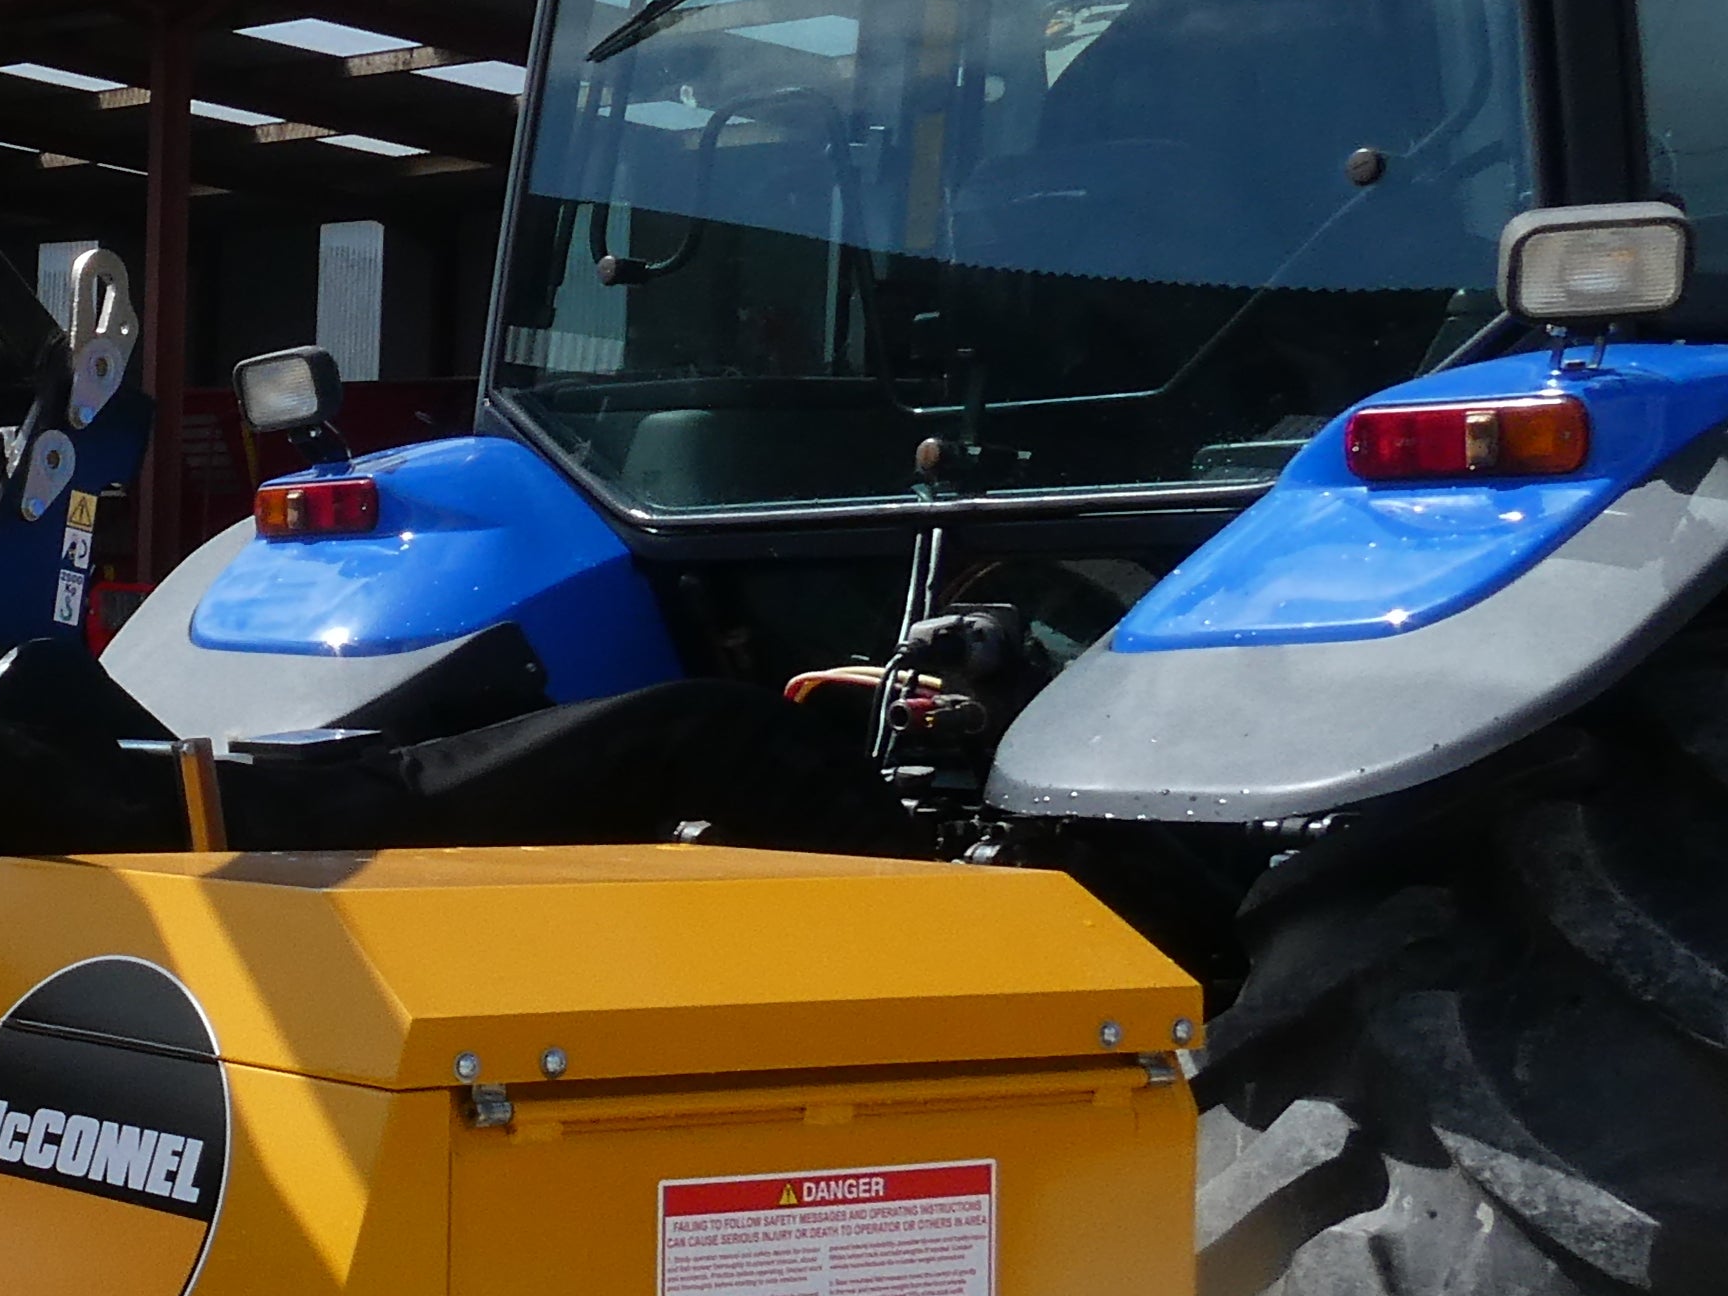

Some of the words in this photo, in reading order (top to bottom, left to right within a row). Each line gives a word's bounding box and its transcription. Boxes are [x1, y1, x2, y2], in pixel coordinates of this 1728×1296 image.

[802, 1177, 884, 1202] DANGER
[710, 1218, 722, 1231] TO
[724, 1216, 761, 1230] FOLLOW
[763, 1214, 797, 1227] SAFETY
[761, 1230, 792, 1242] INJURY
[810, 1225, 839, 1238] DEATH
